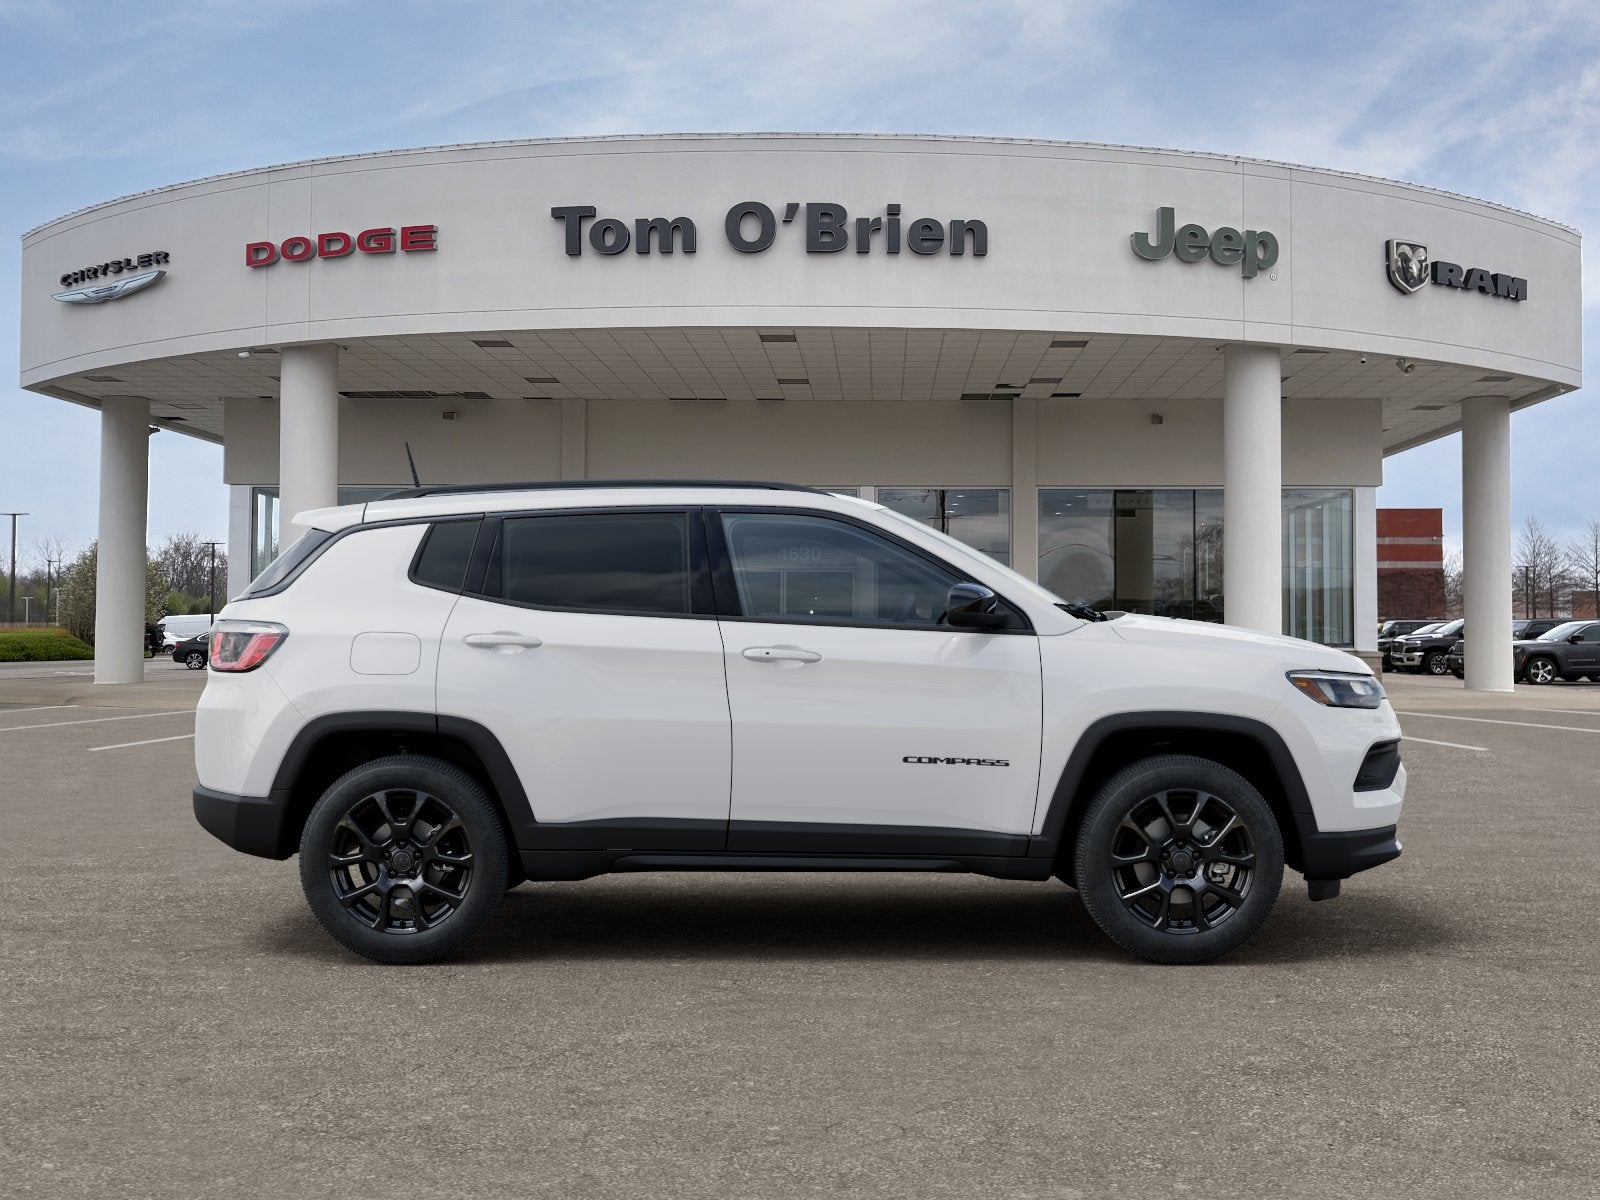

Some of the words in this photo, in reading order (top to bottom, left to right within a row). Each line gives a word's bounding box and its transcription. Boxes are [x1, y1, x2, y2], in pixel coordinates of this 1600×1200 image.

[245, 224, 438, 268] DODGE
[551, 206, 697, 256] Tom
[725, 201, 988, 256] O'Brien
[1131, 207, 1280, 279] Jeep
[60, 250, 170, 287] CHRYSLER
[1431, 260, 1528, 302] RAM
[776, 547, 821, 562] 4630
[902, 756, 1010, 767] COMPASS
